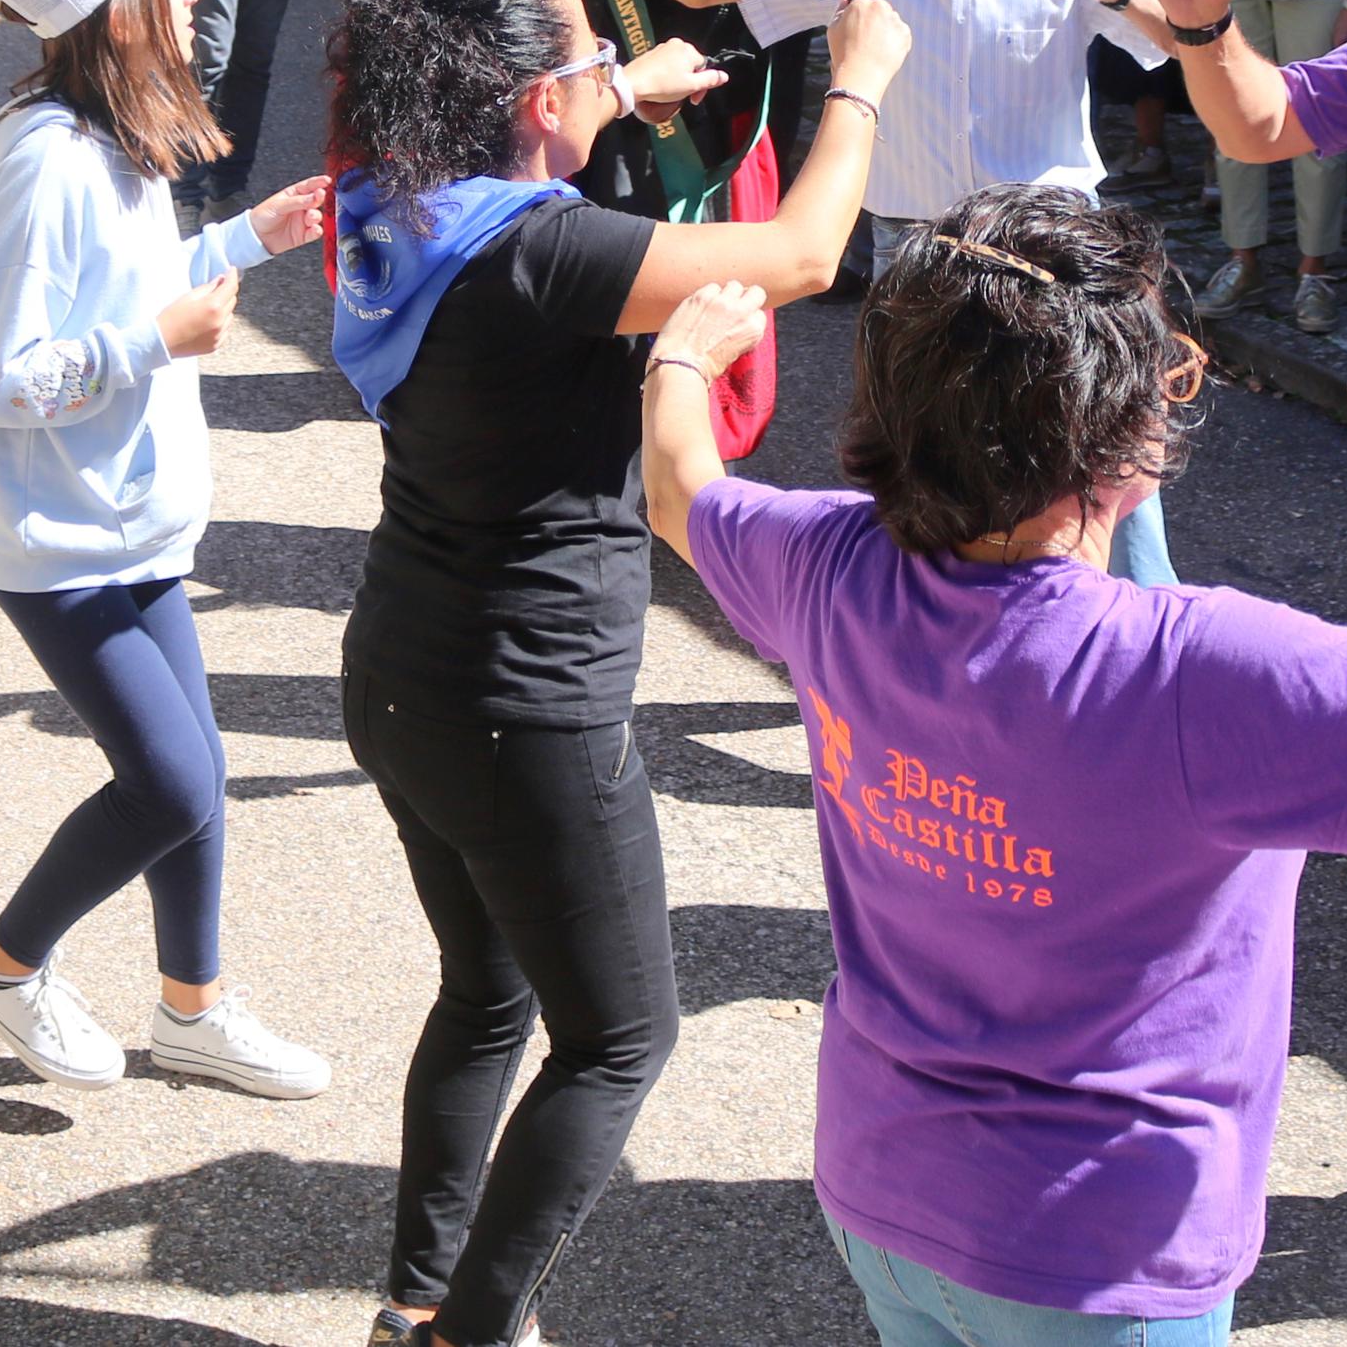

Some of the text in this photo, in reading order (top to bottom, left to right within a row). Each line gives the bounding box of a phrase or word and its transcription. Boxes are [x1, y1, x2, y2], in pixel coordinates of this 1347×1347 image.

[861, 785, 1055, 877] Castilla
[884, 748, 1007, 829] Peña
[866, 821, 1053, 907] Desde 1978
